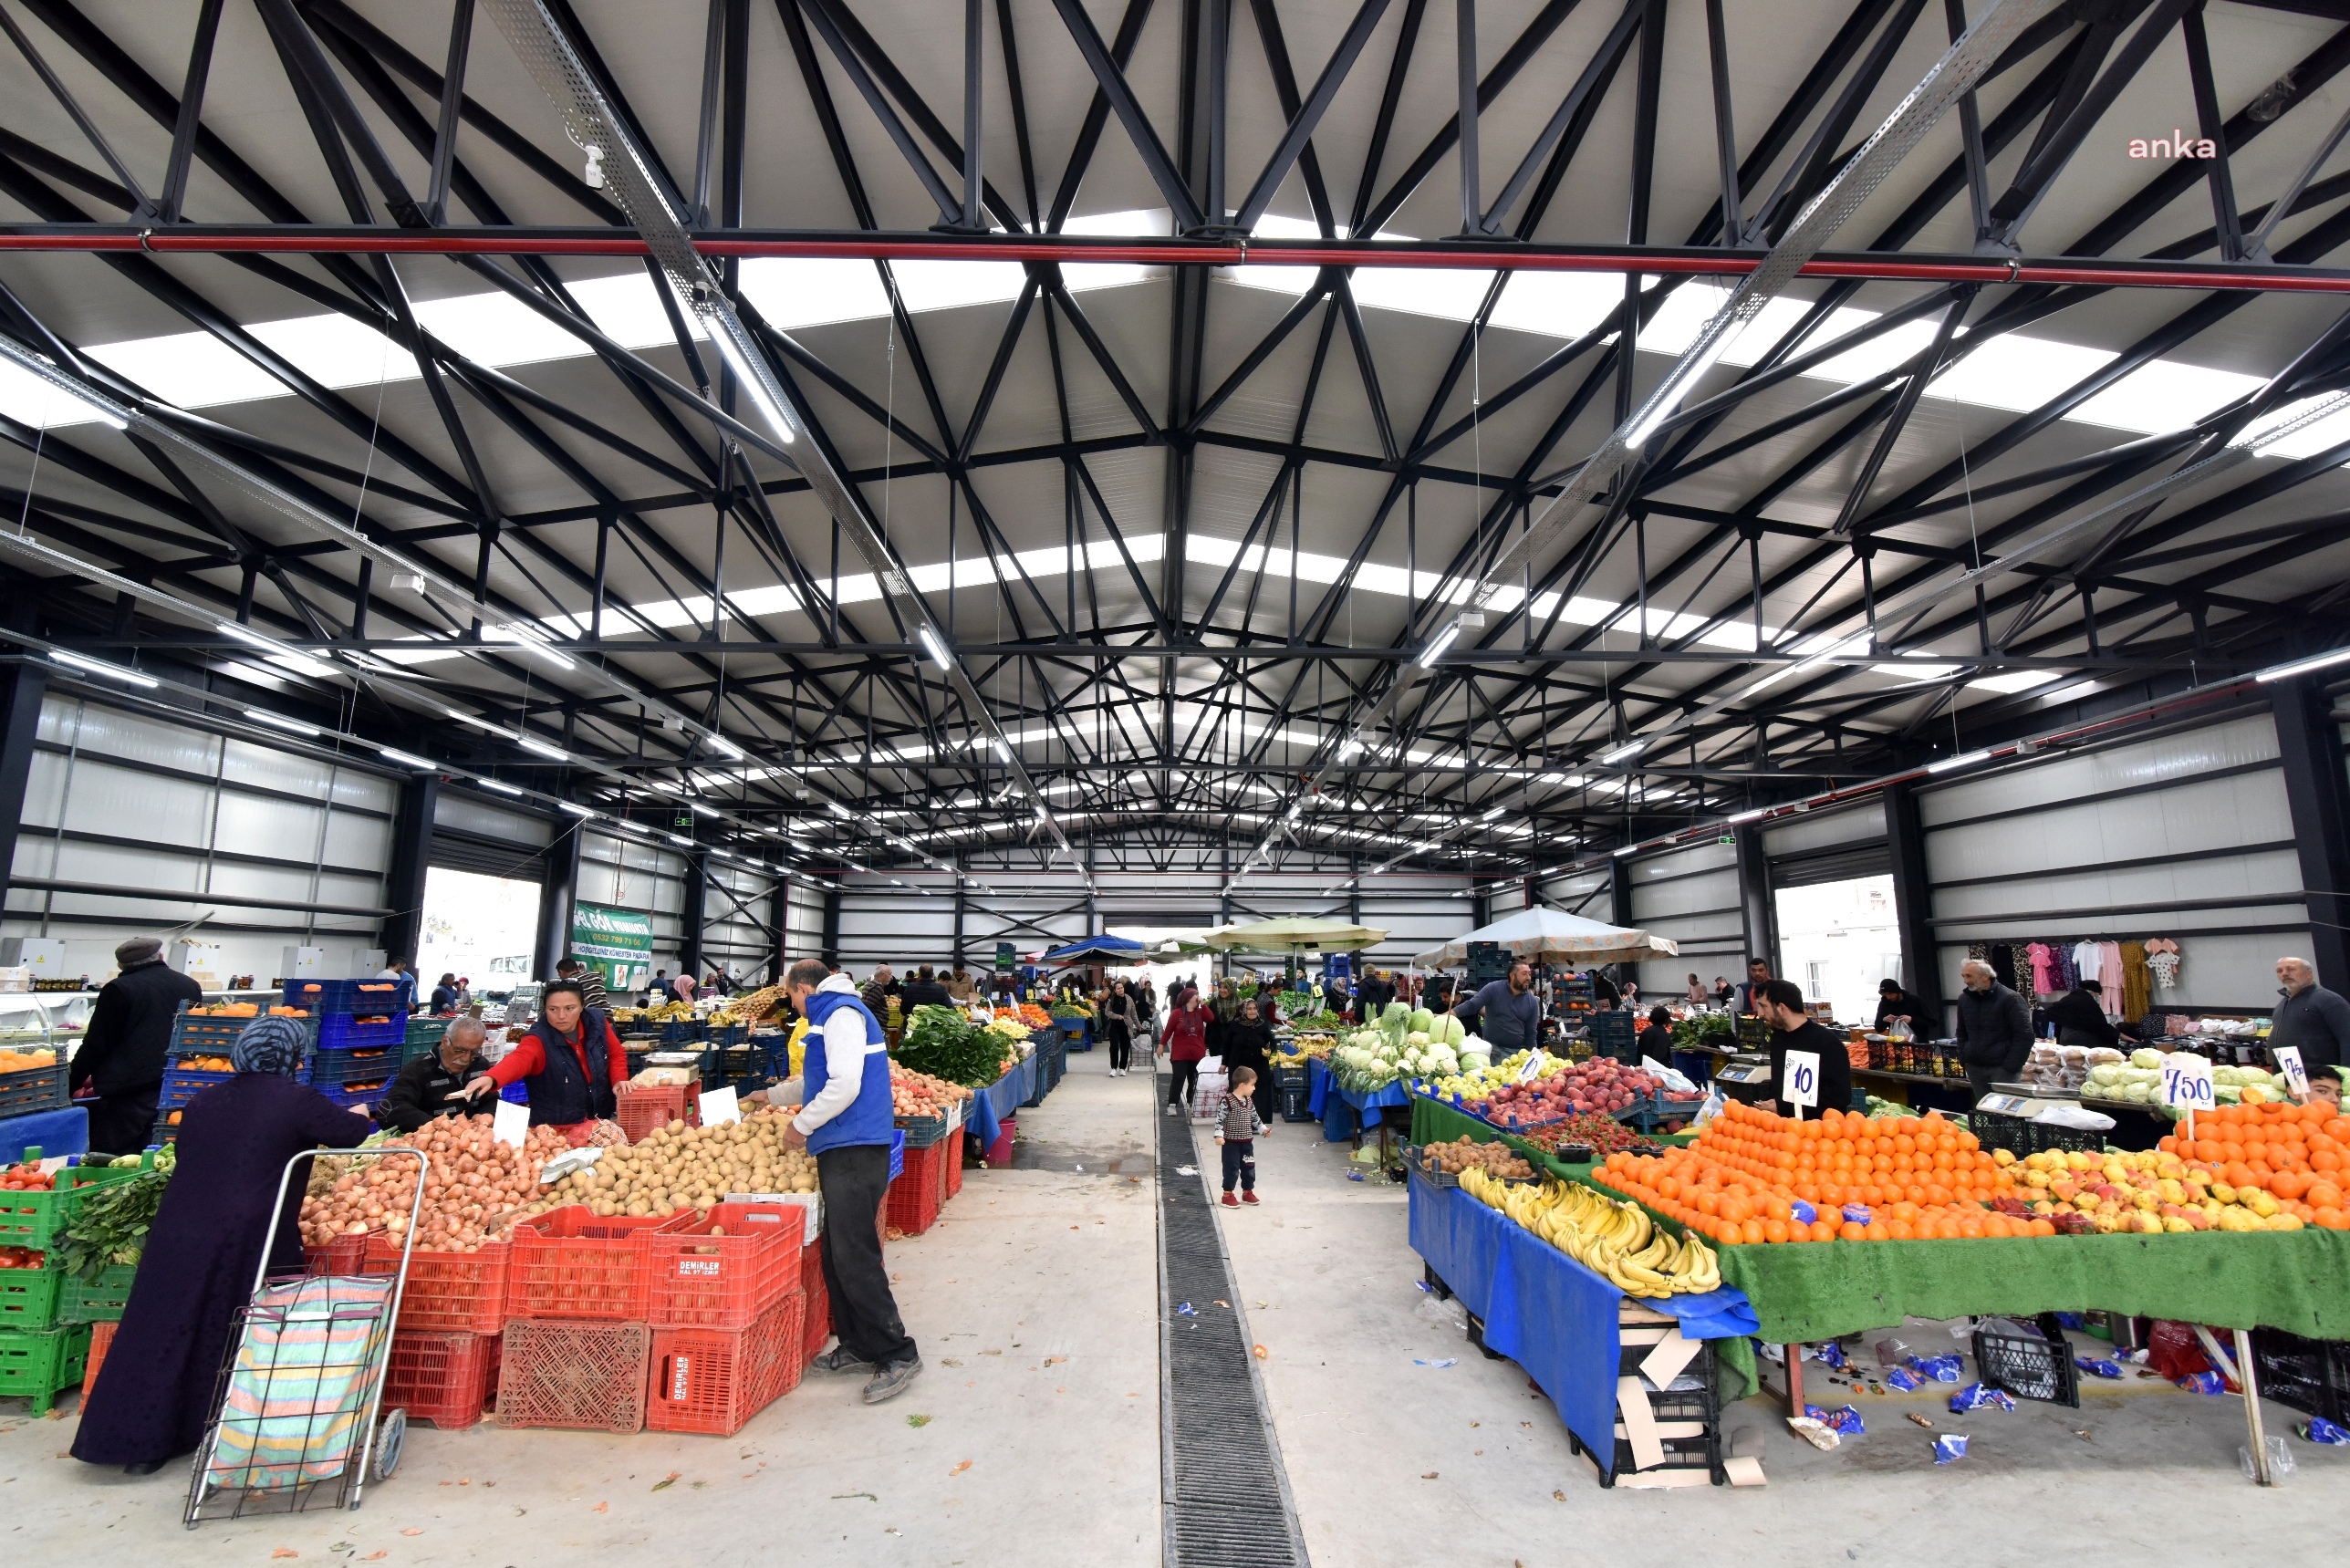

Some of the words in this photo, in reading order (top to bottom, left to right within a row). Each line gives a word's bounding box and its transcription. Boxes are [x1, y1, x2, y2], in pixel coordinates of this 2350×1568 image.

[592, 932, 609, 942] 0532
[610, 935, 623, 944] 799
[624, 937, 631, 945] 71
[1794, 1064, 1813, 1094] 10
